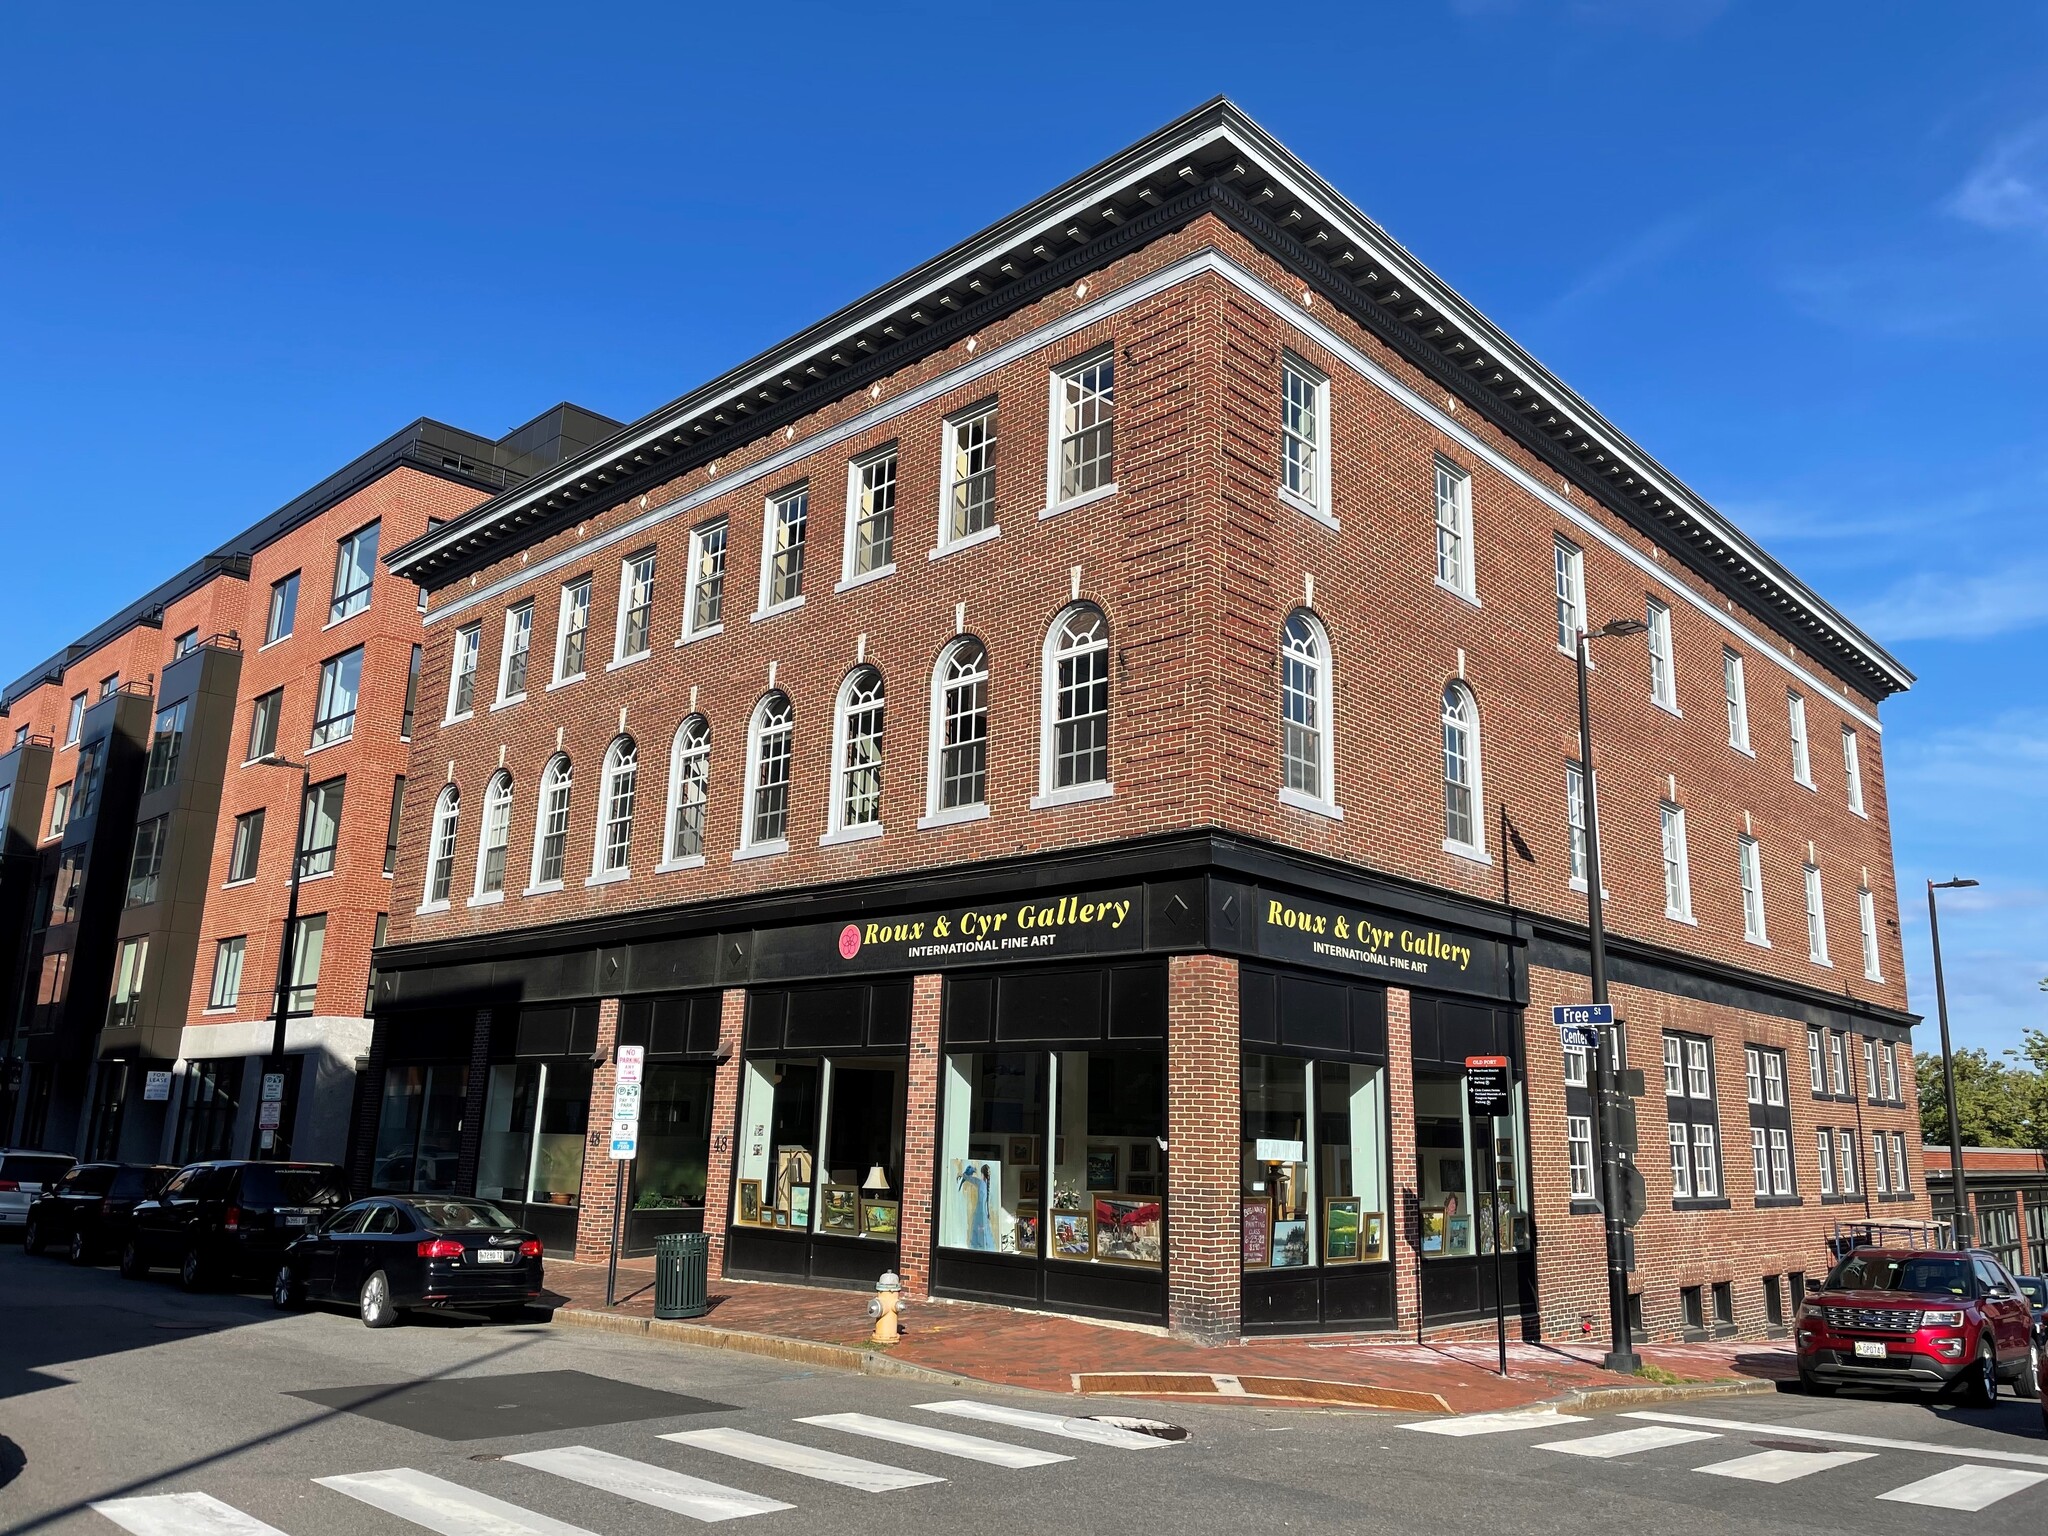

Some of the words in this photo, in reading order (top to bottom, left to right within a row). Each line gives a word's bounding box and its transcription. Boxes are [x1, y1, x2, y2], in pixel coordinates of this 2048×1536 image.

[863, 923, 925, 945] Roux
[933, 915, 951, 938] &
[960, 912, 1008, 941] Cyr
[1017, 896, 1130, 929] Gallery
[1267, 900, 1327, 935] Roux
[1334, 915, 1350, 939] &
[1357, 920, 1394, 953] Cyr
[1401, 930, 1471, 971] Gallery
[908, 939, 999, 957] INTERNATIONAL
[1001, 937, 1028, 950] FINE
[1030, 934, 1056, 947] ART
[1313, 941, 1389, 966] INTERNATIONAL
[1389, 956, 1410, 970] FINE
[1411, 960, 1428, 973] ART
[1564, 1008, 1589, 1022] Free
[1594, 1007, 1601, 1015] St
[1563, 1028, 1588, 1044] Center
[589, 1131, 600, 1146] 48
[714, 1136, 727, 1152] 48
[1258, 1141, 1302, 1159] FRAMING
